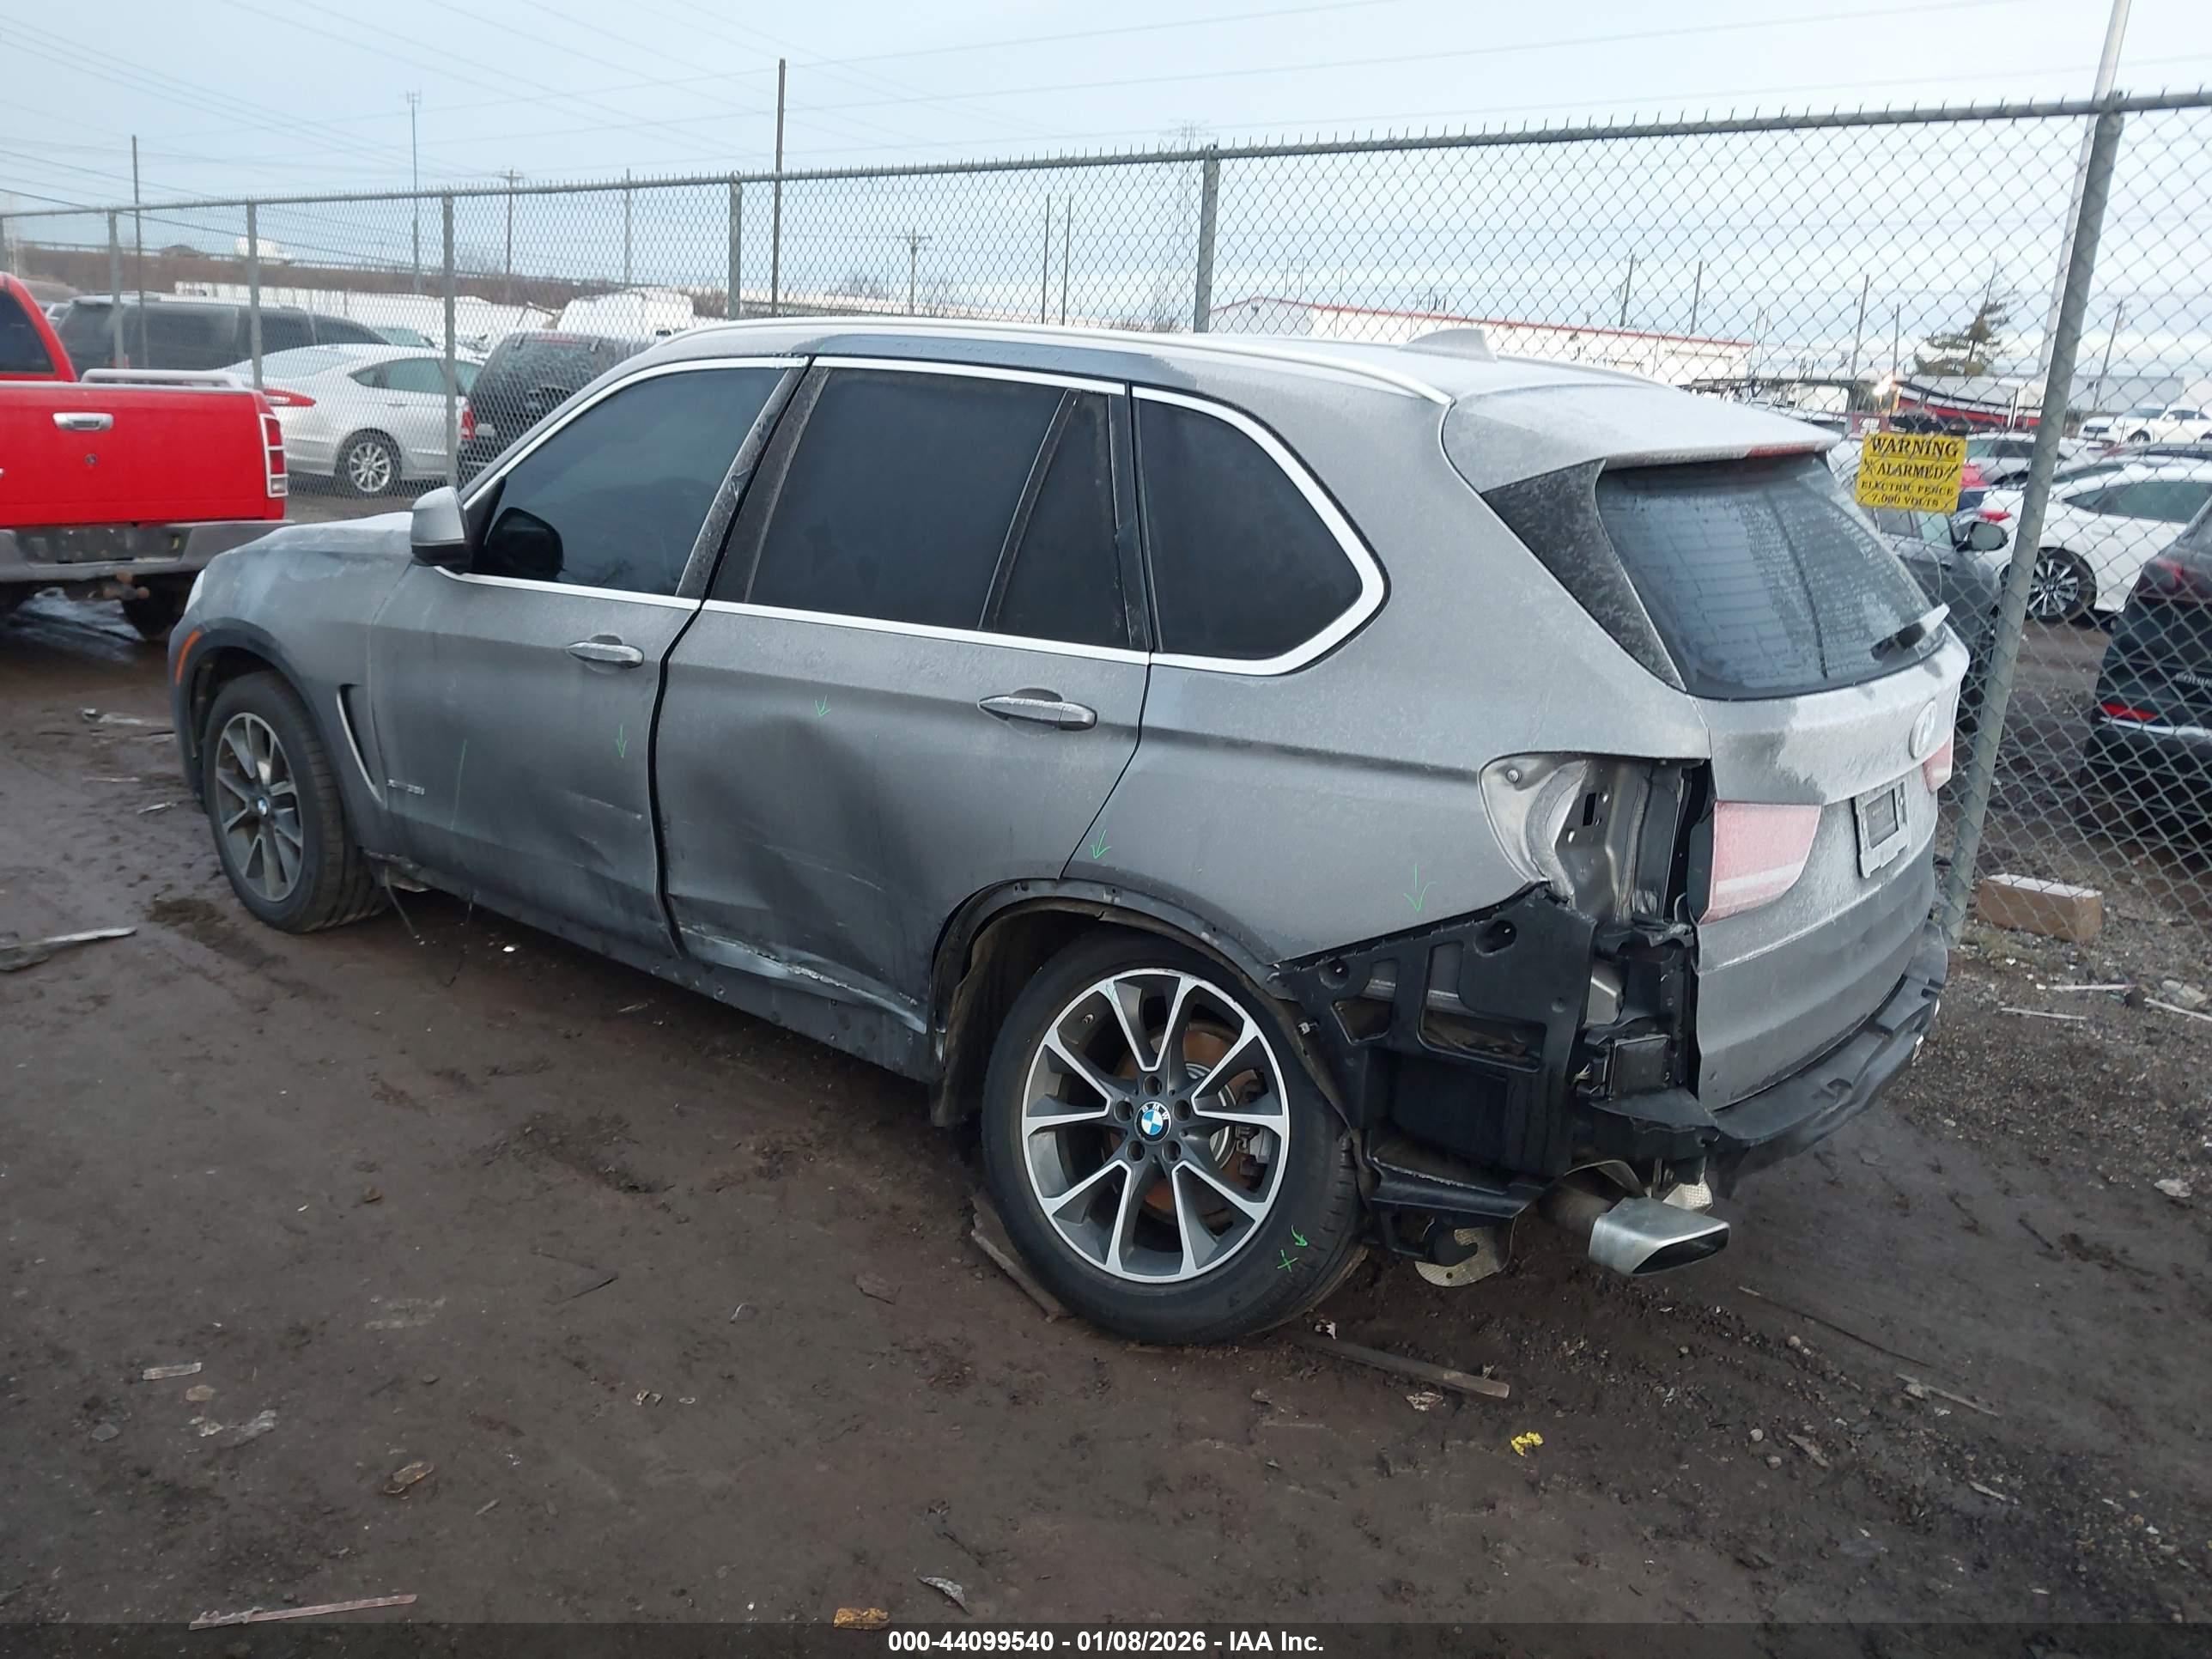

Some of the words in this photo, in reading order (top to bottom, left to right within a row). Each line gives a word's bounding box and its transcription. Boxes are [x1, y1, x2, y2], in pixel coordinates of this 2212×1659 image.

[1871, 435, 1958, 459] WARNING
[1877, 462, 1944, 480] ALARMED
[1917, 484, 1954, 496] FENCE
[1141, 1103, 1169, 1121] BMW
